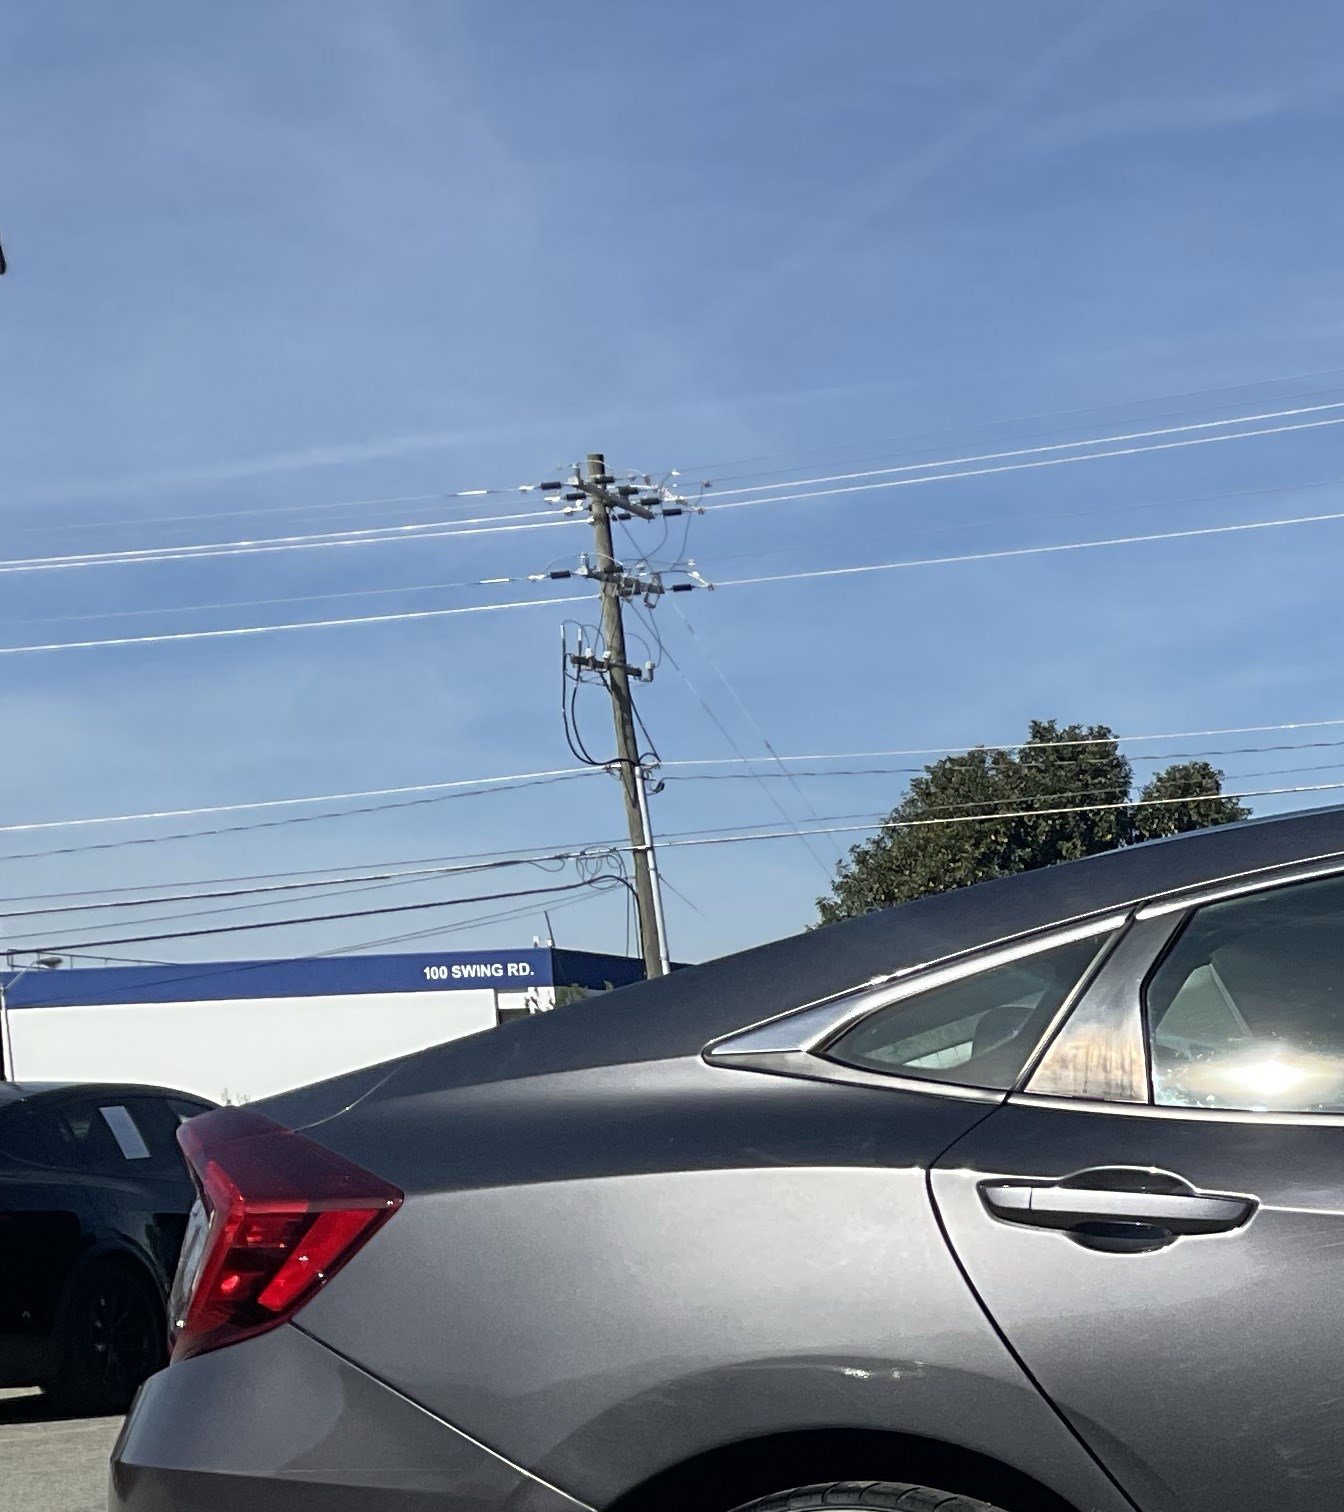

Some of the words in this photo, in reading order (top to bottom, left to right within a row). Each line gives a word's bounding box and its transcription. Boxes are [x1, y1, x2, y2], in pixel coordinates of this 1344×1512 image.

[423, 965, 449, 980] 100
[451, 963, 504, 979] SWING
[506, 962, 535, 977] RD.
